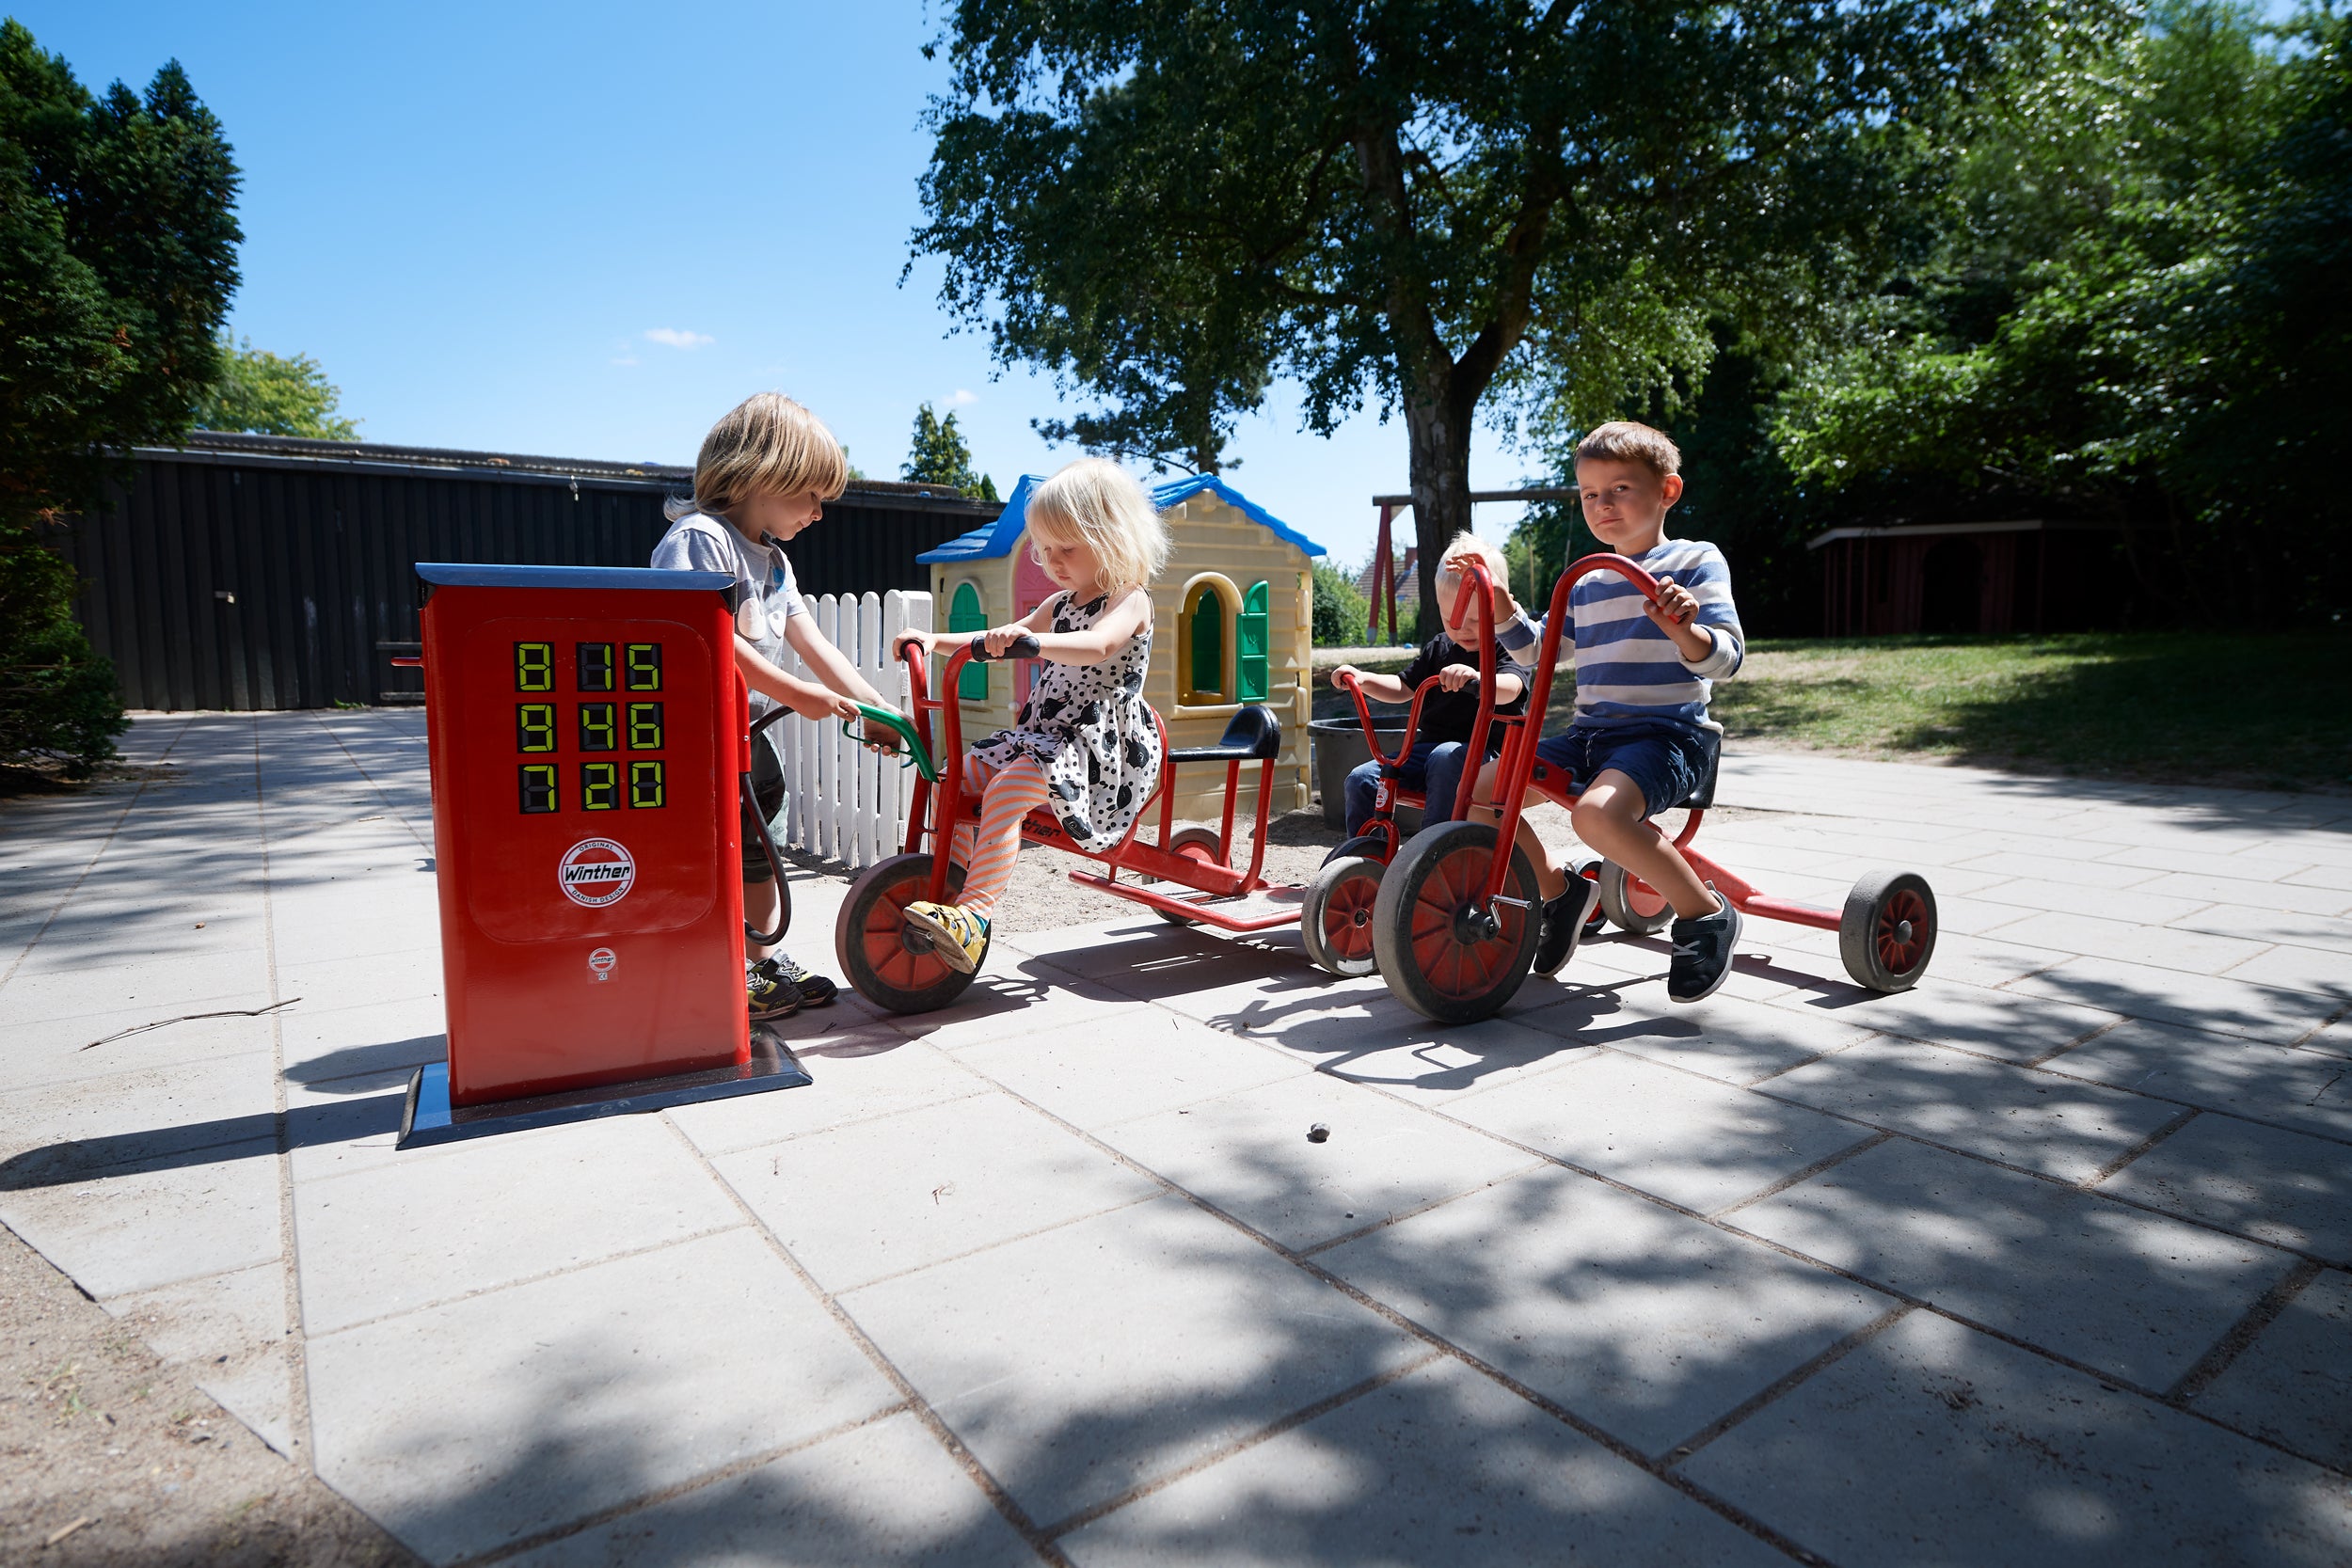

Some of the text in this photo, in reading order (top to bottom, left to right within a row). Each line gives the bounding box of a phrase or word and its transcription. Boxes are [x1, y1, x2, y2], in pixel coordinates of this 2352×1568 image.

[1022, 818, 1061, 837] ther
[579, 842, 613, 851] ORIGINAL
[564, 864, 630, 881] Winther
[571, 886, 624, 903] DANISH DESIGN
